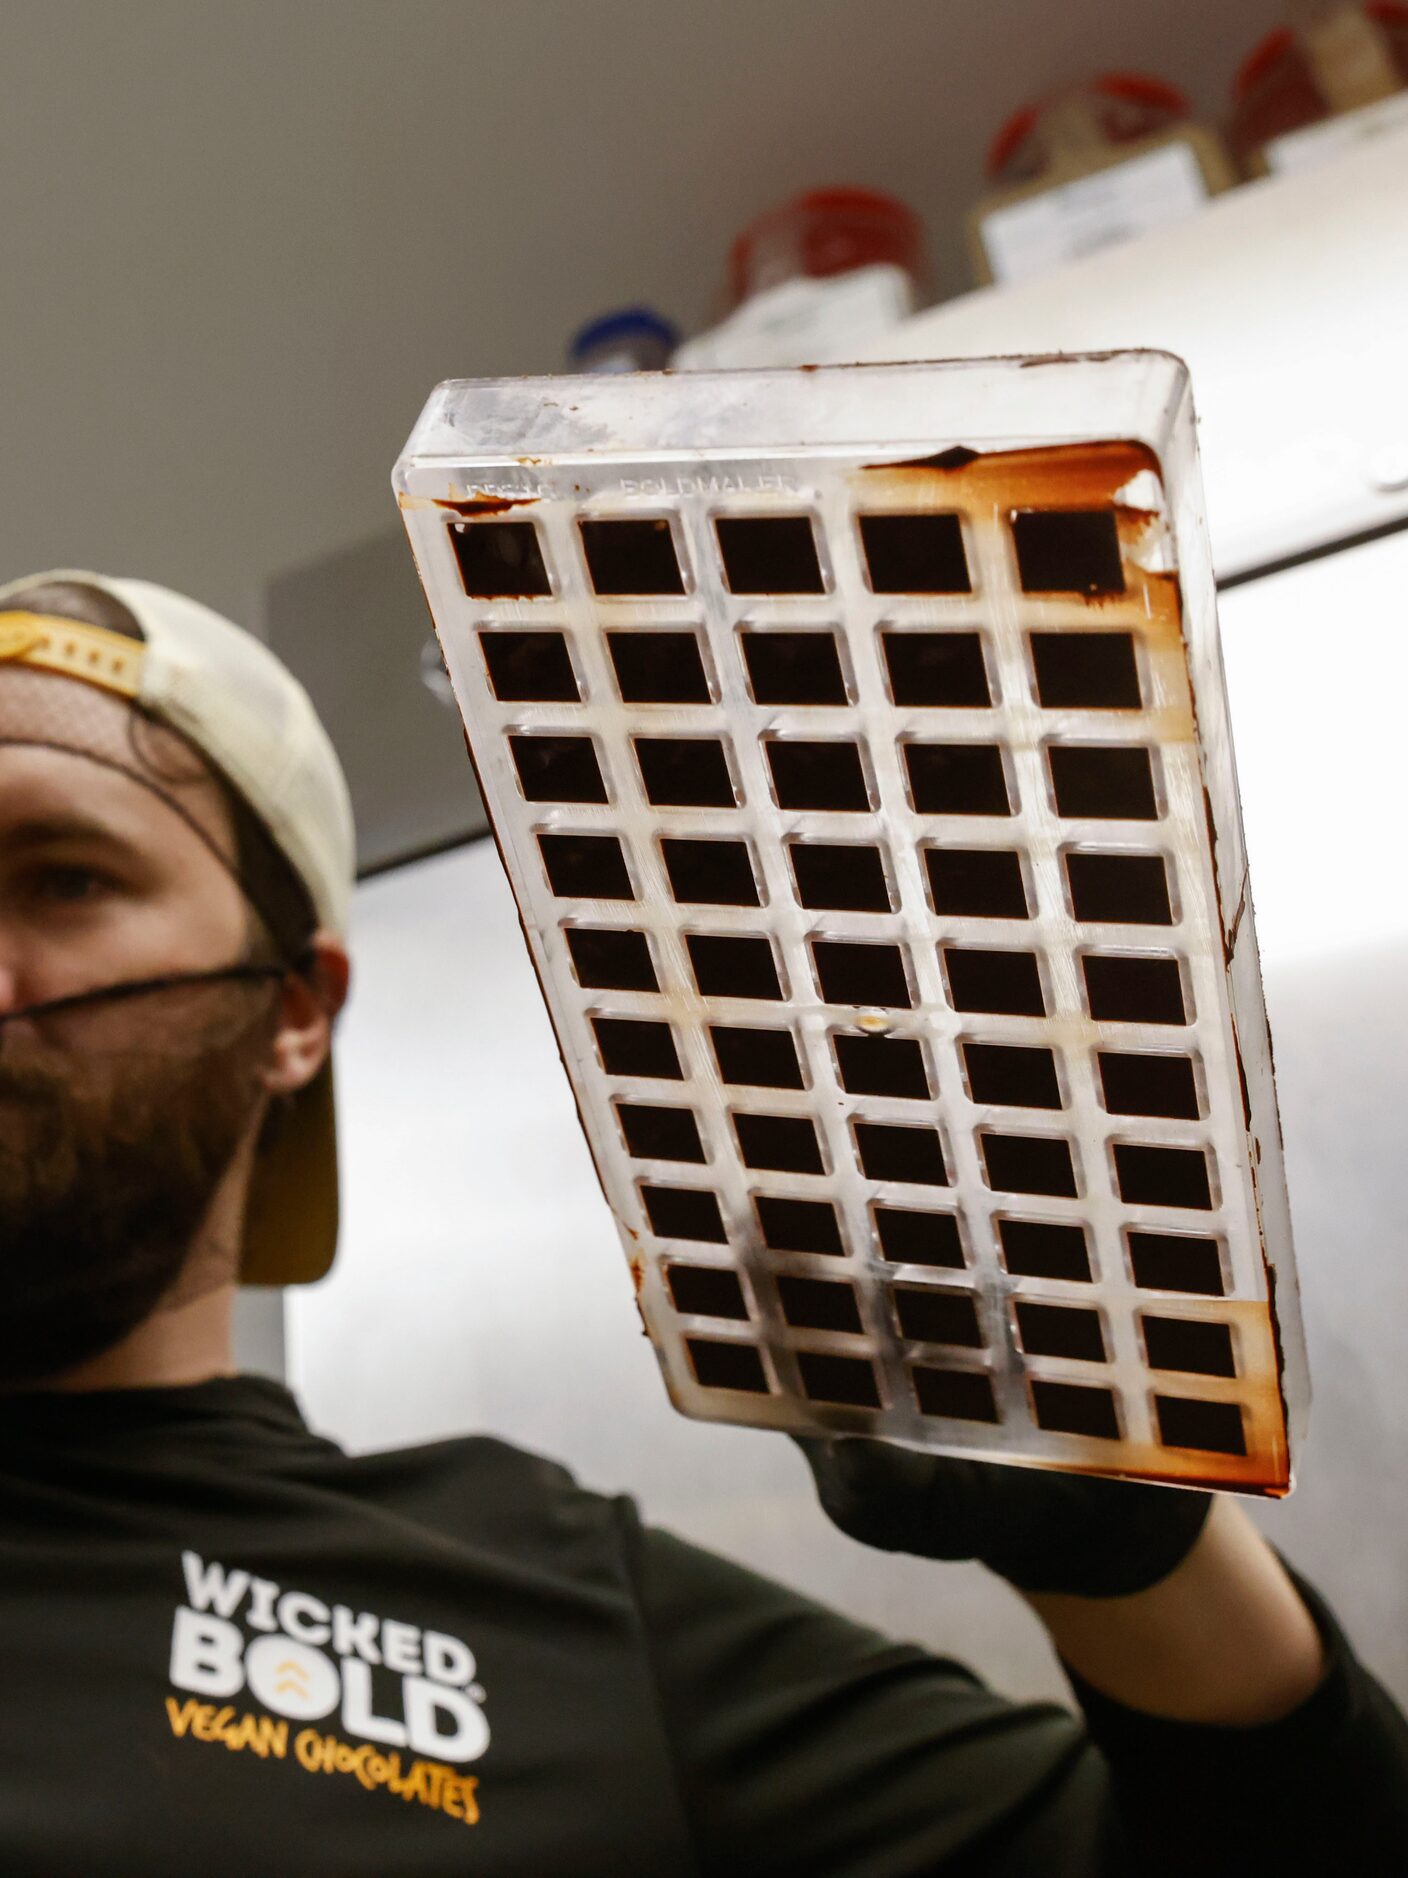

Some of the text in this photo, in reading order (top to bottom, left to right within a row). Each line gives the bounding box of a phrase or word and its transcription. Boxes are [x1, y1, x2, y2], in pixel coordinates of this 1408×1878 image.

[169, 1604, 491, 1763] BOLD
[181, 1549, 477, 1687] WICKED
[165, 1696, 481, 1825] VEGAN CHOCOLATES
